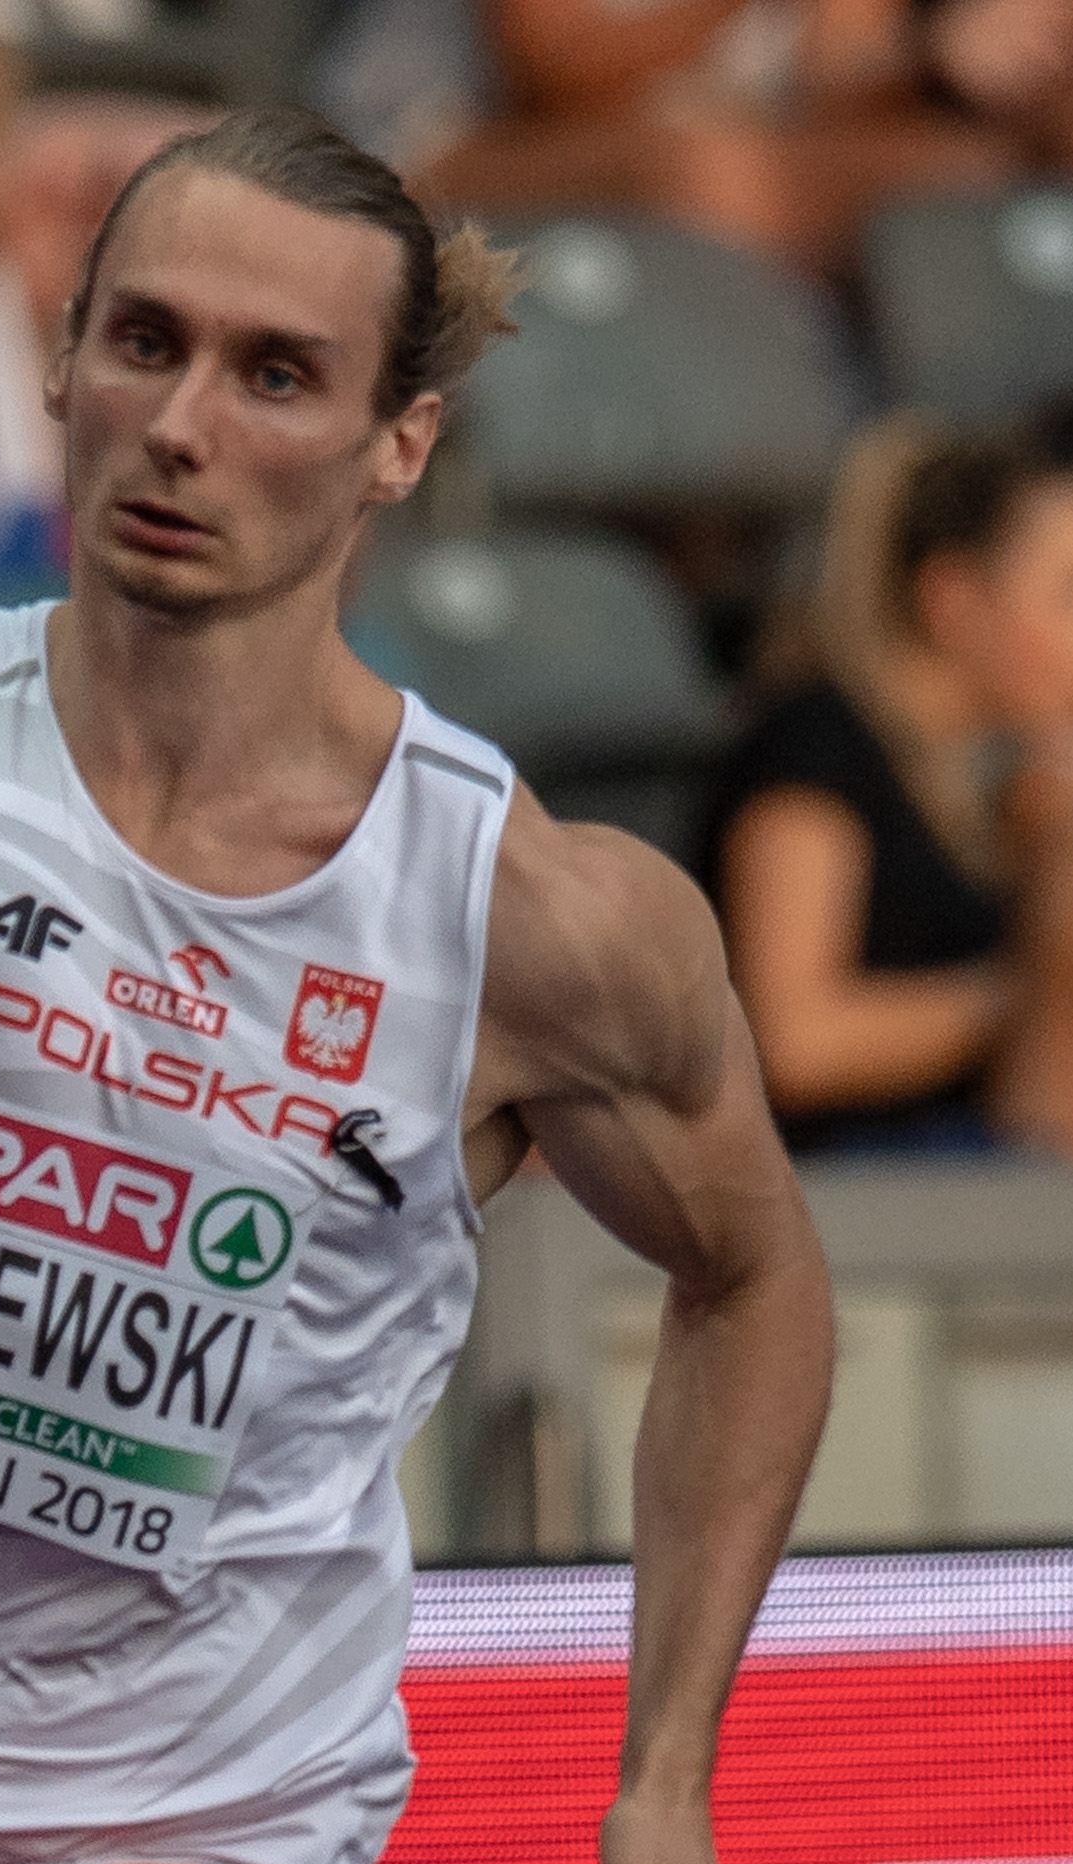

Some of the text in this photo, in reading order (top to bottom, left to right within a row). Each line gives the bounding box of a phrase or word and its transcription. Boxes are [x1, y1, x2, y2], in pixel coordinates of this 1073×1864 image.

[110, 976, 220, 1032] ORLEN
[308, 970, 378, 998] POLSKA
[31, 1469, 174, 1555] 2018
